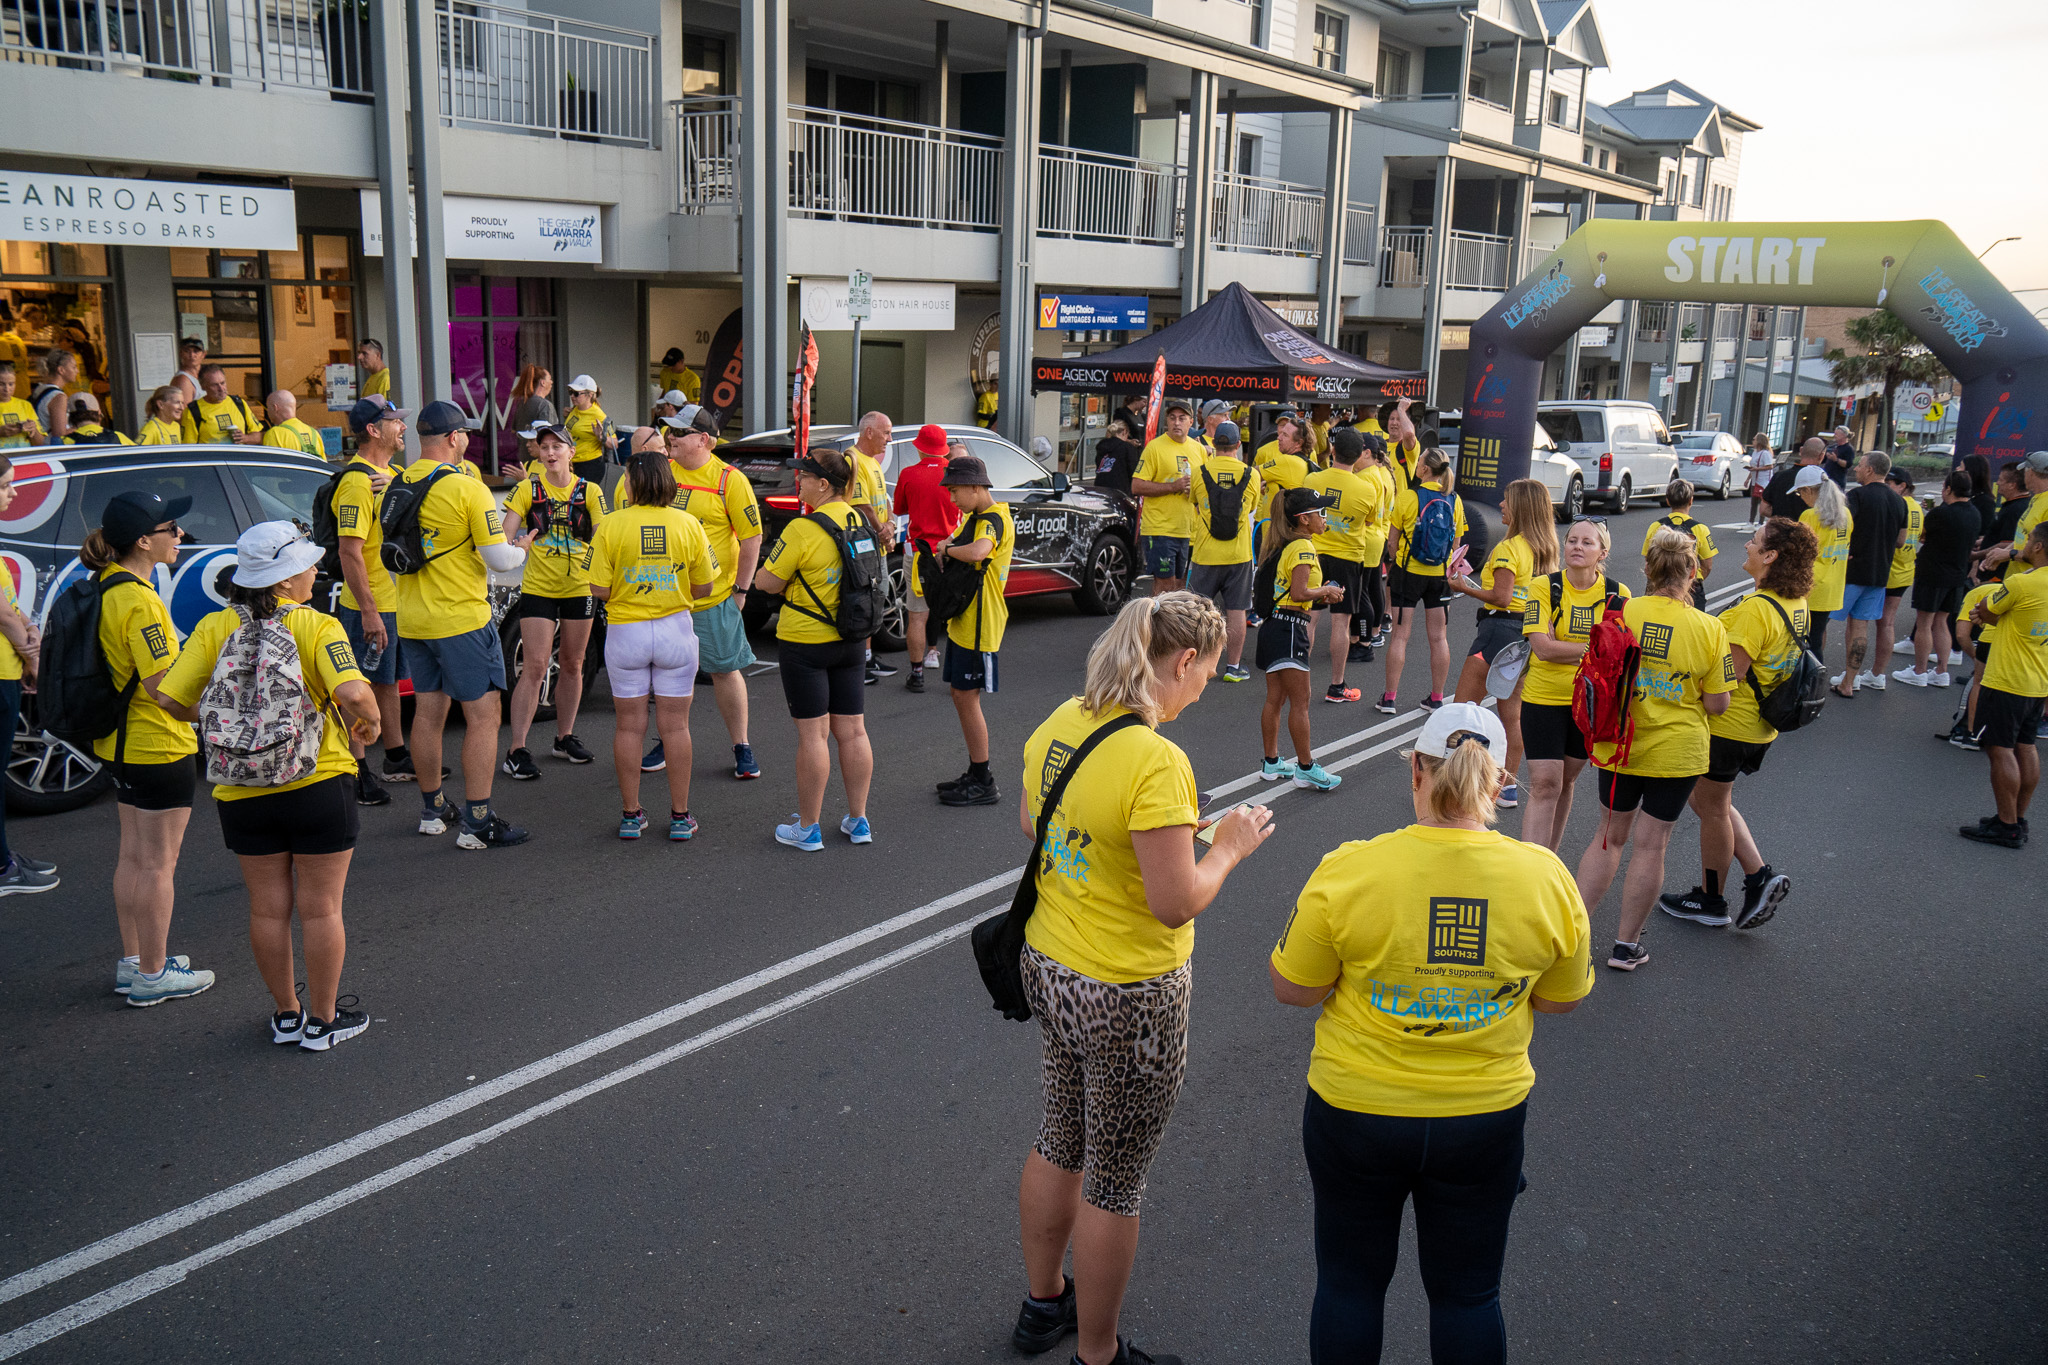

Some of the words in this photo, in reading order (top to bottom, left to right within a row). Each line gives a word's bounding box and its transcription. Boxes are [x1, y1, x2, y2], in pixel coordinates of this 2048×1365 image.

[471, 216, 508, 227] PROUDLY
[538, 217, 554, 228] THE
[555, 218, 582, 229] GREAT
[23, 216, 146, 236] ESPRESSO
[161, 223, 216, 239] BARS
[539, 227, 593, 239] ILLAWARRA
[465, 229, 515, 240] SUPPORTING
[568, 238, 593, 248] WALK
[1664, 235, 1827, 285] START
[853, 275, 868, 287] 1P
[899, 299, 919, 309] HAIR
[922, 300, 950, 310] HOUSE
[1060, 304, 1076, 315] Right
[1075, 304, 1095, 314] Choice
[1060, 315, 1091, 324] MORTGAGES
[1097, 316, 1118, 324] FINANCE
[695, 330, 710, 344] 20
[1405, 378, 1426, 397] 5111
[1914, 396, 1930, 407] 40
[1483, 409, 1506, 419] good
[1974, 444, 1994, 455] feel
[1995, 447, 2026, 459] good
[1460, 477, 1497, 488] SOUTH32
[1013, 513, 1035, 535] feel
[1036, 511, 1068, 539] good
[1649, 687, 1683, 702] WALK
[1434, 949, 1478, 959] SOUTH32
[1414, 966, 1447, 976] Proudly
[1448, 967, 1495, 979] supporting
[1368, 978, 1412, 1000] THE
[1418, 987, 1495, 1004] GREAT
[280, 1018, 298, 1028] NIKE
[306, 1025, 323, 1035] NIKE
